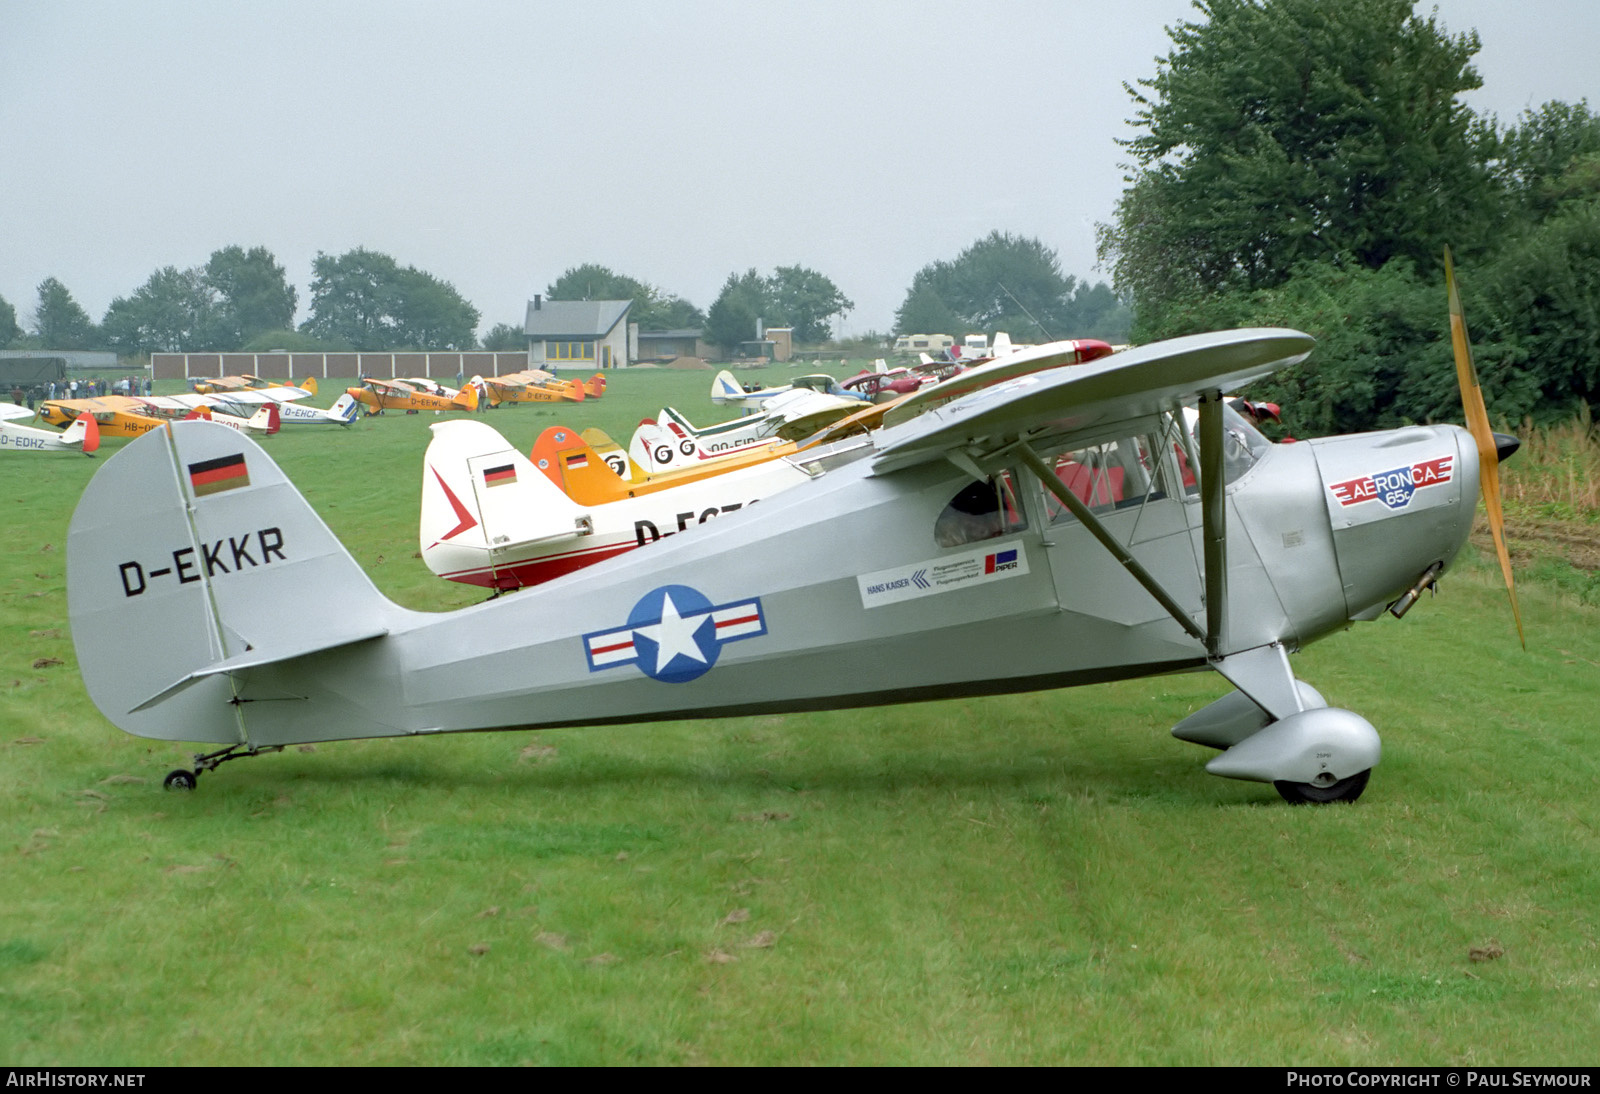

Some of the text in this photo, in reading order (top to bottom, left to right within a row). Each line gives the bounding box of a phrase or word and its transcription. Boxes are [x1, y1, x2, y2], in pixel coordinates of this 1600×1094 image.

[1353, 466, 1438, 499] AERONCA
[118, 526, 287, 597] D-EKKR
[995, 561, 1018, 572] PIPER
[867, 578, 910, 595] HANS KAISER
